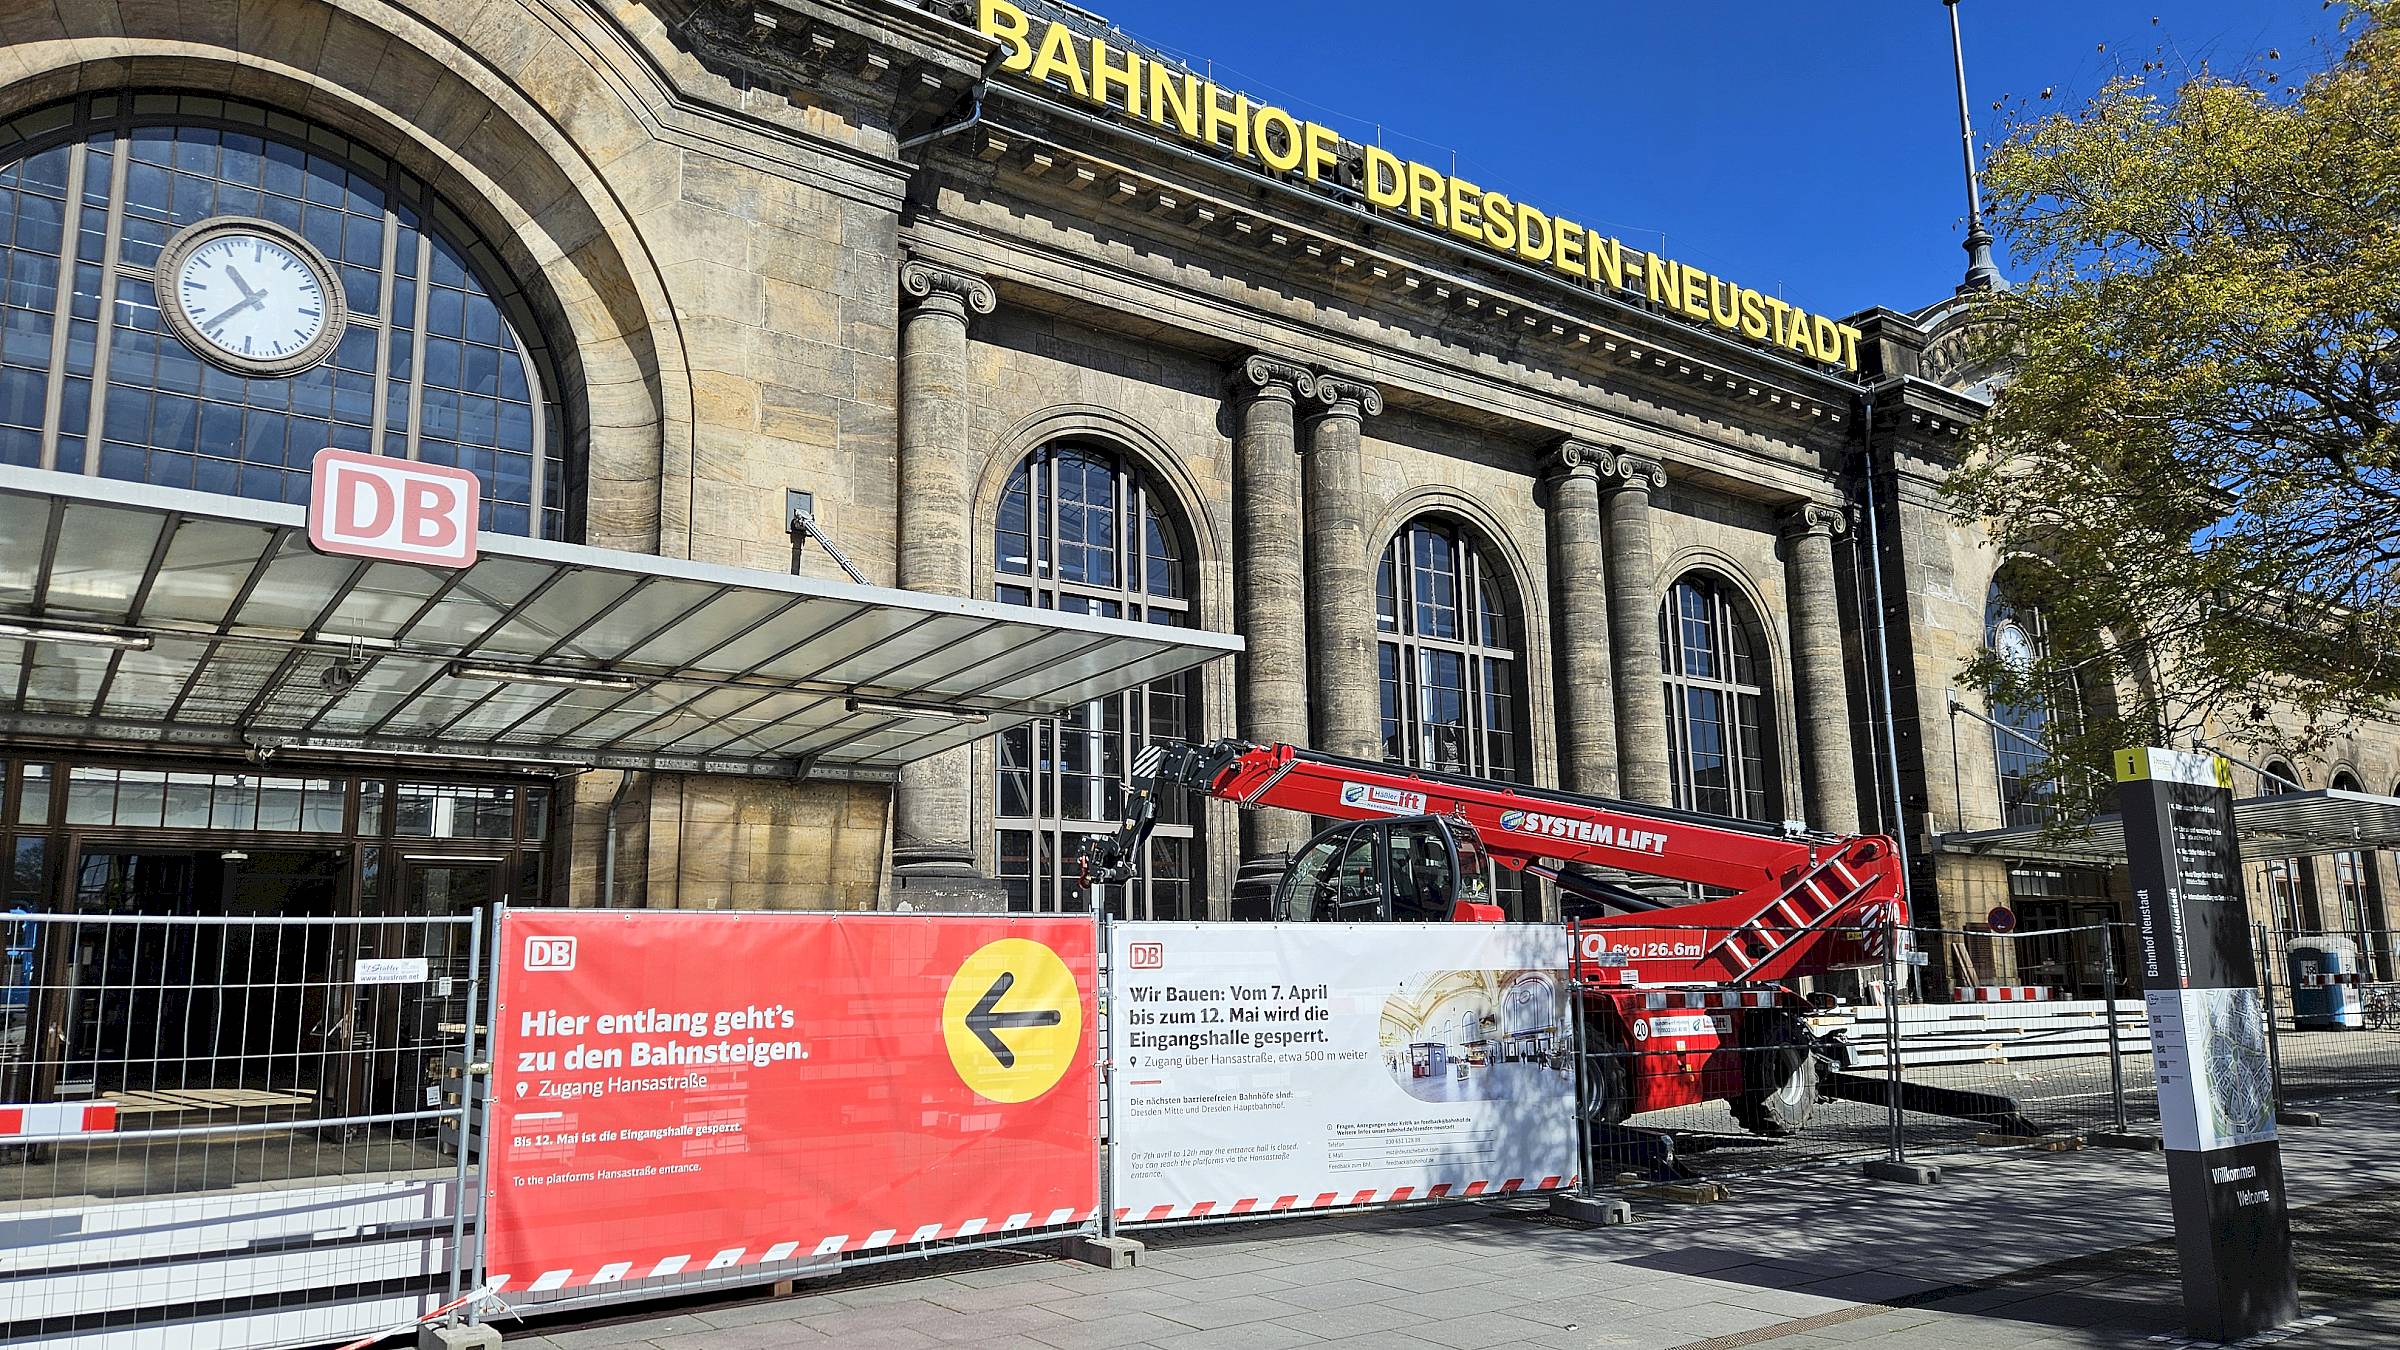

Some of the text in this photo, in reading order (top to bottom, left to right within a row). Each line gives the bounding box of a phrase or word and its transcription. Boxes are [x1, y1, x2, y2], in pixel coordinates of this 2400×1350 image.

[977, 0, 1862, 373] BAHNHOF DRESDEN-NEUSTADT
[334, 468, 458, 549] DB
[1524, 812, 1668, 854] SYSTEM LIFT
[2169, 888, 2182, 934] Neustadt
[2137, 888, 2159, 977] Bahnhof Neustadt
[2176, 935, 2188, 977] Bahnhof
[1129, 984, 1328, 1003] Wir Bauen: Vom 7. April
[520, 1009, 590, 1037] Hier
[596, 1008, 708, 1037] entlang
[1129, 1005, 1329, 1025] bis zum 12. Mai wird die
[1129, 1028, 1329, 1051] Eingangshalle gesperrt.
[1635, 1022, 1647, 1037] 20
[517, 1037, 809, 1072] zu den Bahnsteigen.
[1144, 1049, 1368, 1069] Zugang über Hansastraße, etwa 500 m weiter
[538, 1073, 708, 1099] Zugang Hansastraße
[1130, 1097, 1144, 1106] Die
[1146, 1096, 1181, 1106] nächsten
[1183, 1093, 1237, 1104] barrierefreien
[1130, 1107, 1162, 1117] Dresden
[1185, 1105, 1200, 1114] und
[1201, 1104, 1232, 1113] Dresden
[513, 1122, 743, 1148] Bis 12. Mai ist die Eingangshalle gesperrt.
[1131, 1152, 1141, 1160] On
[1131, 1161, 1143, 1170] You
[1145, 1161, 1158, 1169] can
[513, 1162, 702, 1187] To the platforms Hansastraße entrance.
[2211, 1165, 2257, 1184] Willkommen
[2236, 1189, 2270, 1207] Welcome
